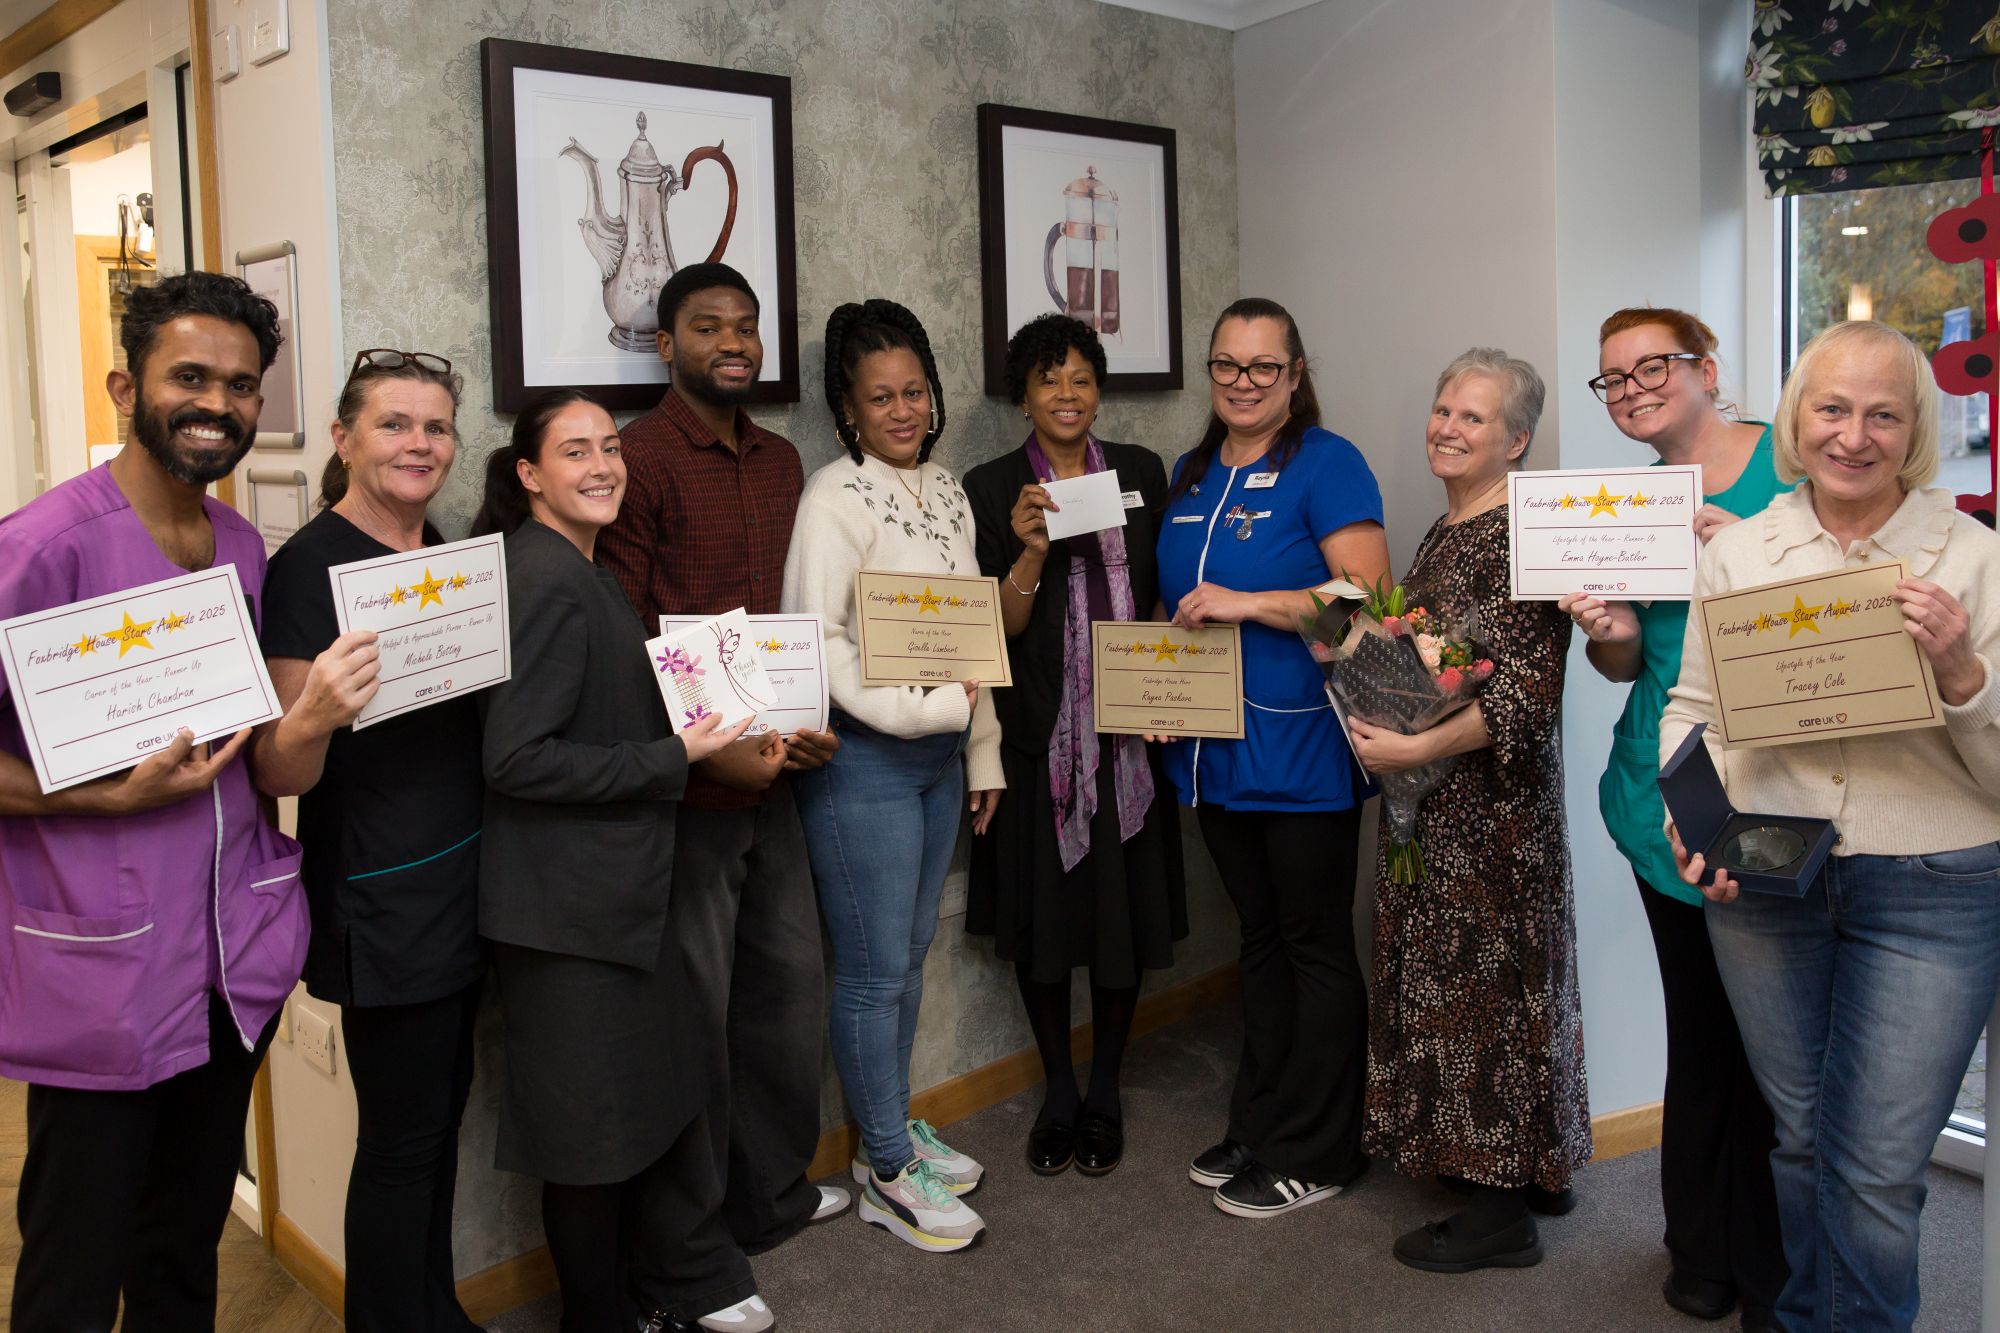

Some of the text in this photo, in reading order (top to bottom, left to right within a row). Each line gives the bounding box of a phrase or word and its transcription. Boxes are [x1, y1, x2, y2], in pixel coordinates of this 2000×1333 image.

[1523, 494, 1684, 512] Foxbridge House Stars Awards 2025
[1552, 535, 1579, 545] Lifestyle
[1580, 535, 1587, 545] of
[1588, 535, 1598, 543] the
[1601, 534, 1615, 543] Year
[1624, 534, 1645, 542] Runner
[1647, 533, 1657, 543] Up
[1561, 551, 1584, 562] Emma
[354, 570, 494, 611] Foxbridge House Stars Awards 2025
[1583, 583, 1604, 591] care
[867, 591, 988, 608] Foxbridge House Stars Awards 2025
[1717, 595, 1892, 637] Foxbridge House Stars Awards 2025
[28, 604, 226, 667] Foxbridge House Stars Awards 2025
[925, 628, 931, 637] of
[760, 641, 811, 651] Awards 2025
[1105, 642, 1228, 656] Foxbridge House Stars Awards 2025
[1775, 653, 1846, 673] Lifestyle of the Year
[84, 689, 107, 701] Carer
[110, 684, 118, 696] of
[120, 678, 132, 689] the
[136, 673, 153, 686] Year
[164, 666, 188, 678] Runner
[191, 660, 202, 673] Up
[1785, 672, 1847, 695] Tracey Cole
[415, 683, 443, 697] care UK
[106, 687, 195, 721] Harish Chandran
[1798, 715, 1835, 728] care UK
[136, 732, 176, 750] care UK
